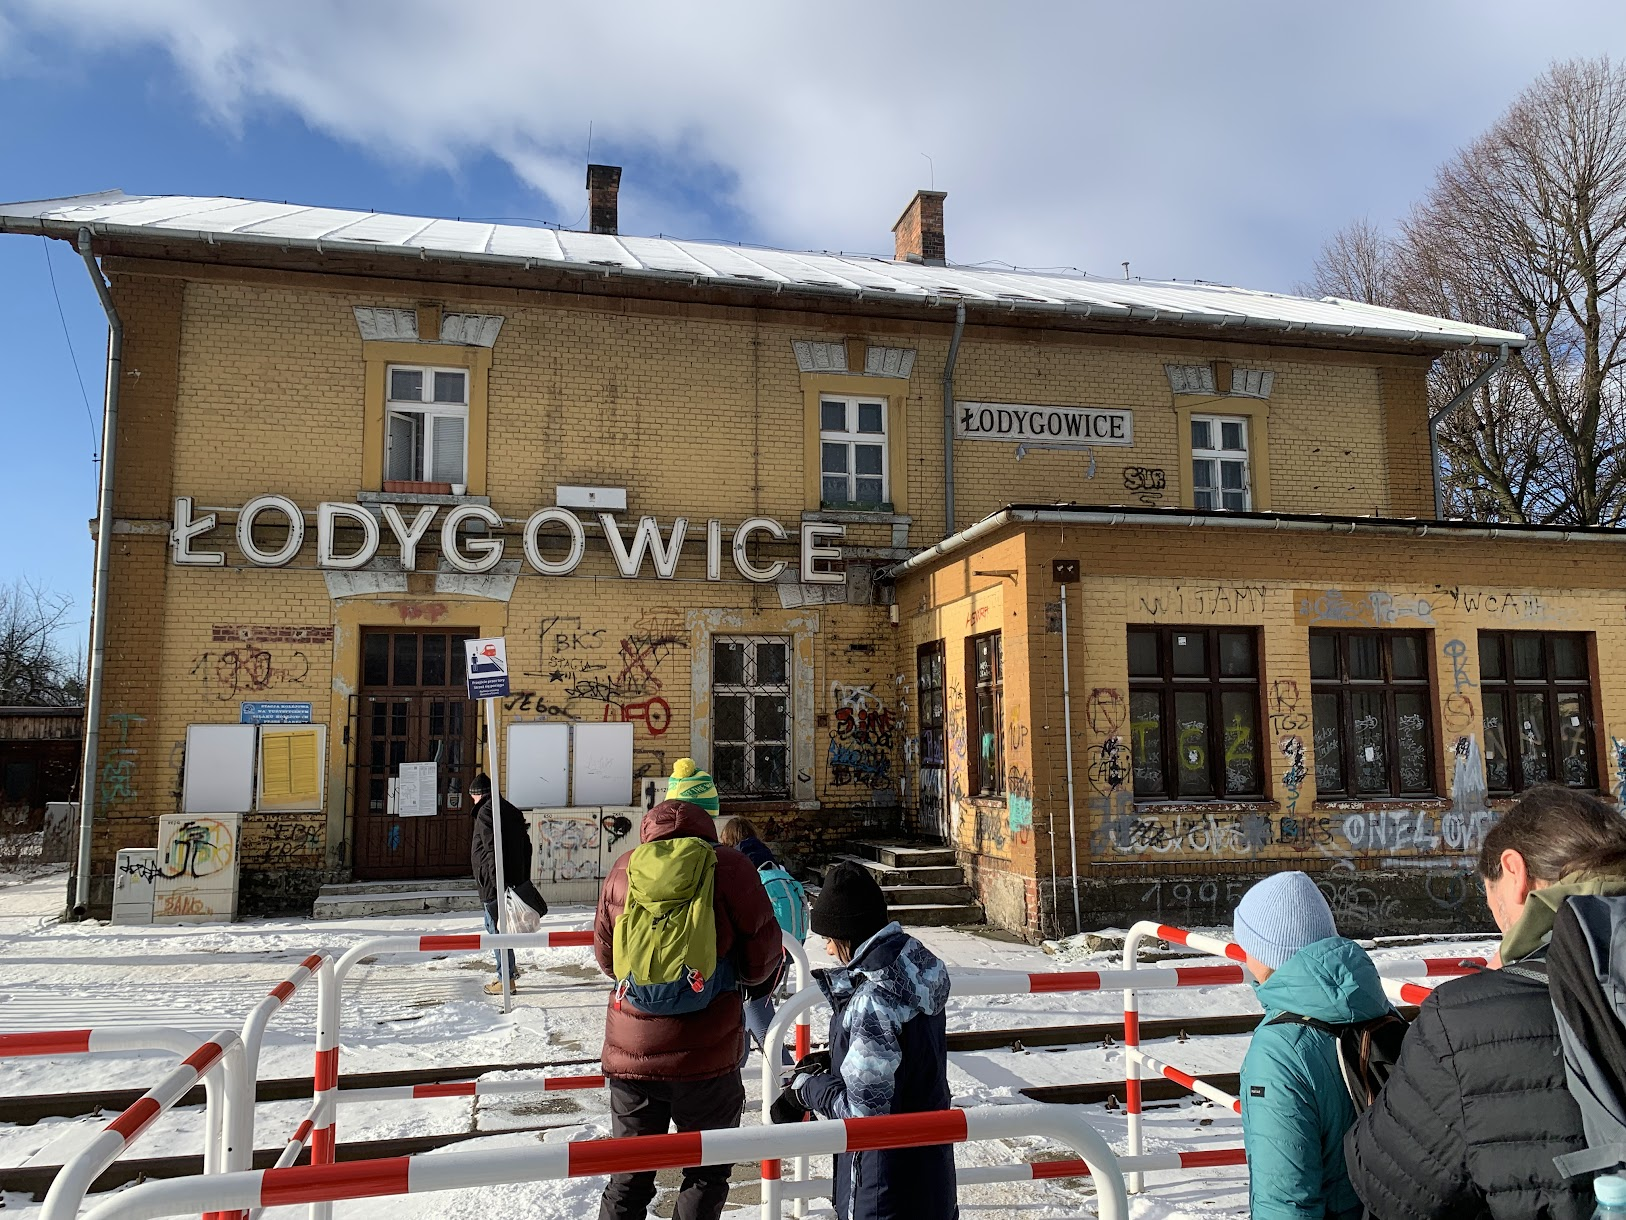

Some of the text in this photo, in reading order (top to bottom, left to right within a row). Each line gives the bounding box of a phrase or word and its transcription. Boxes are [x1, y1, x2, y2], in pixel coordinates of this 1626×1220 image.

[961, 408, 1125, 439] ŁODYGOWICE
[169, 494, 847, 585] ŁODYGOWICE
[555, 630, 607, 653] BKS
